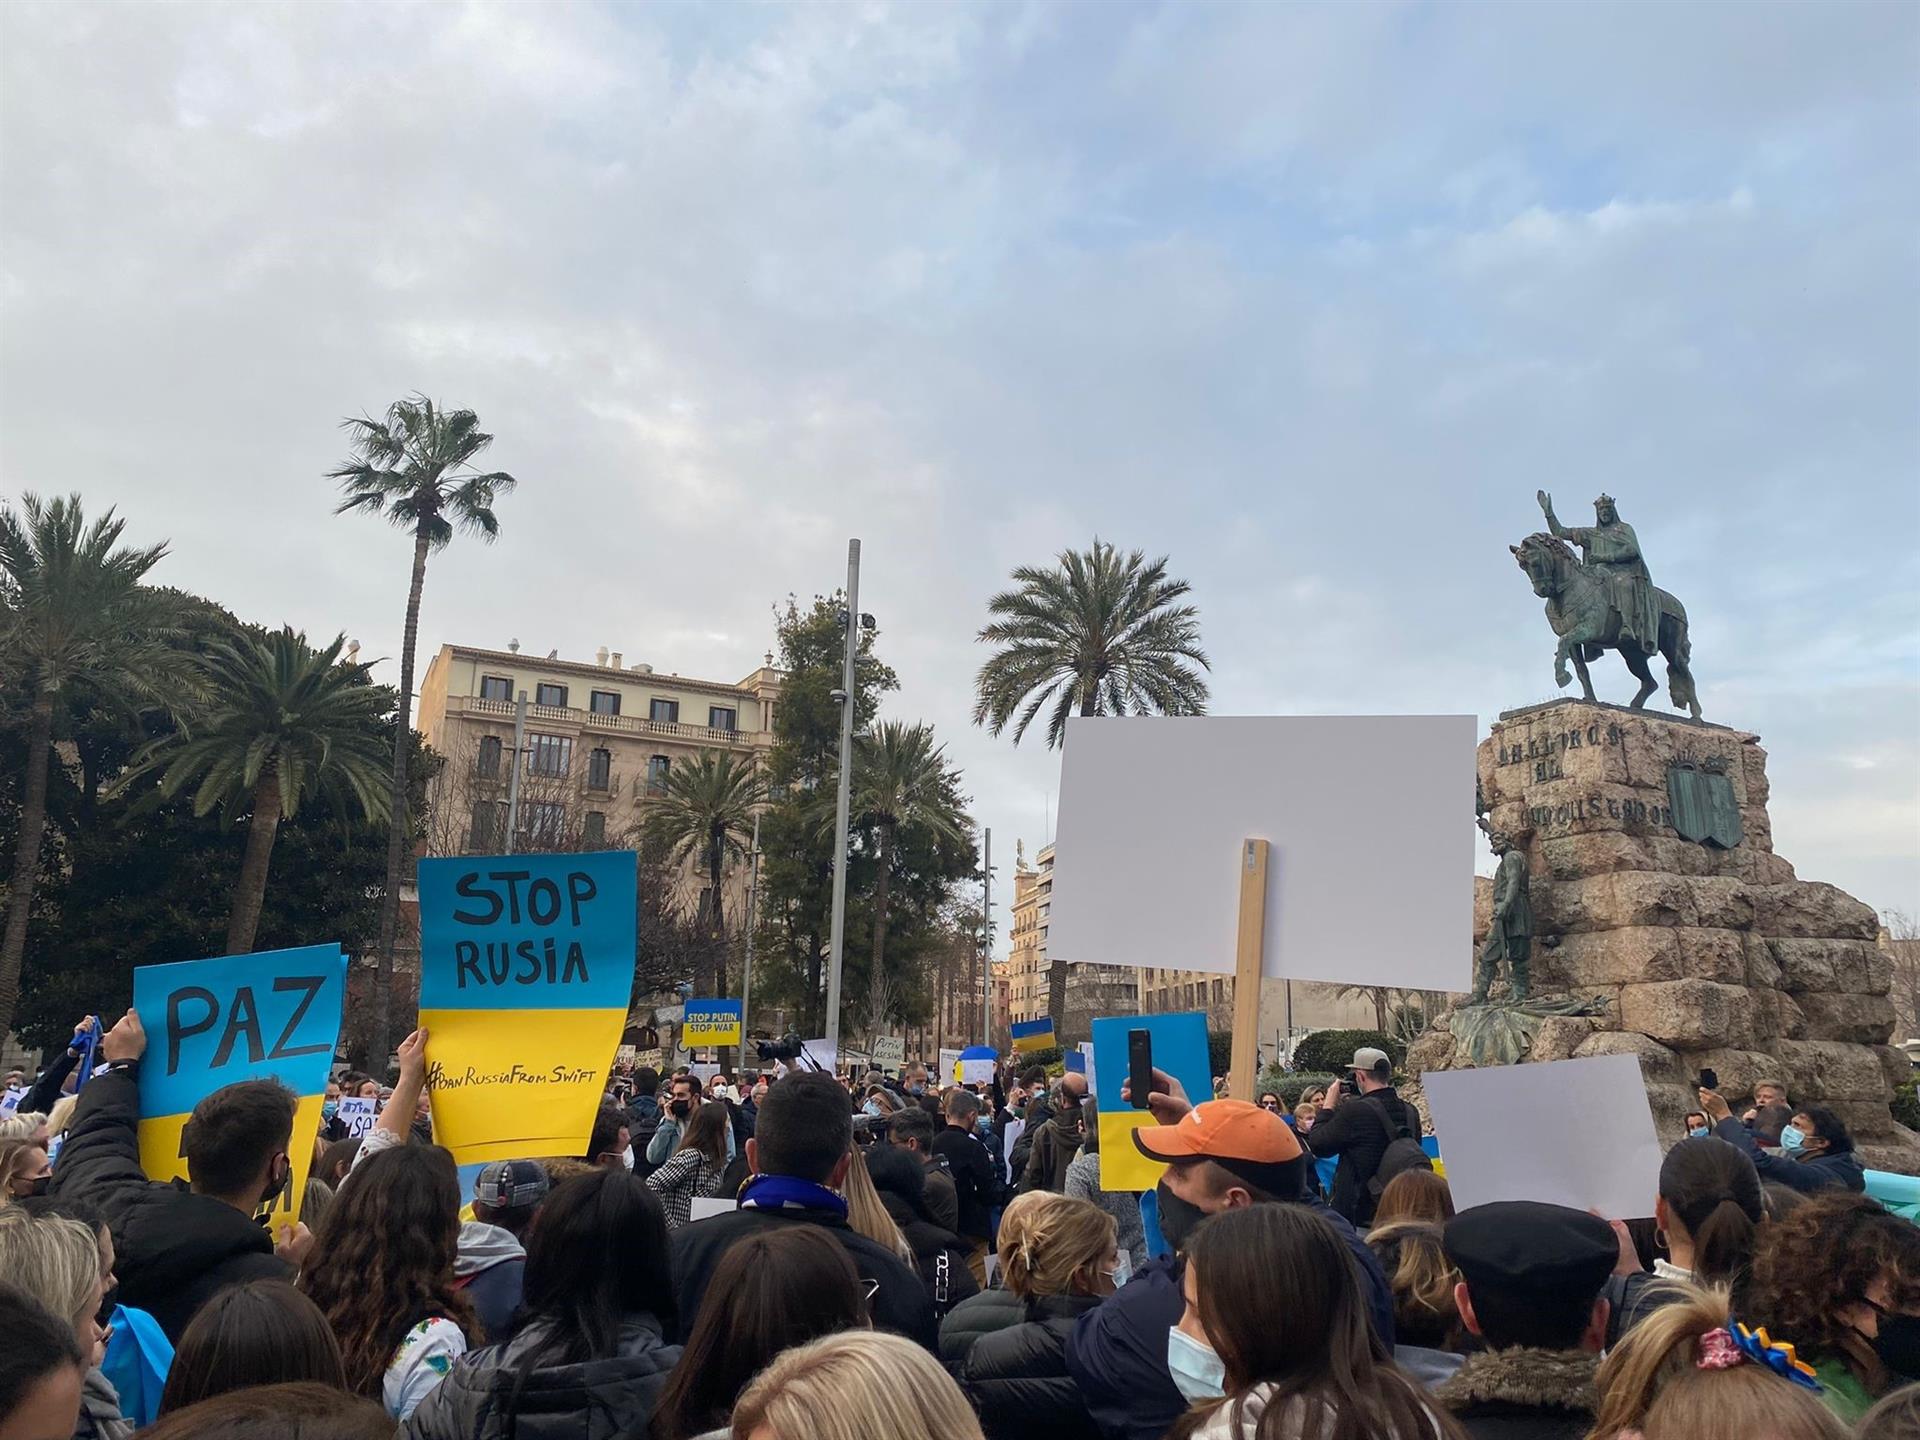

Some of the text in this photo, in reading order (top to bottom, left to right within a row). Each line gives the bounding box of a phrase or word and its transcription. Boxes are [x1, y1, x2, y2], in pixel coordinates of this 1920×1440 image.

[453, 870, 597, 927] STOP
[166, 976, 333, 1076] PAZ
[687, 1012, 737, 1022] STOP PUTIN
[690, 1023, 734, 1033] STOP WAR
